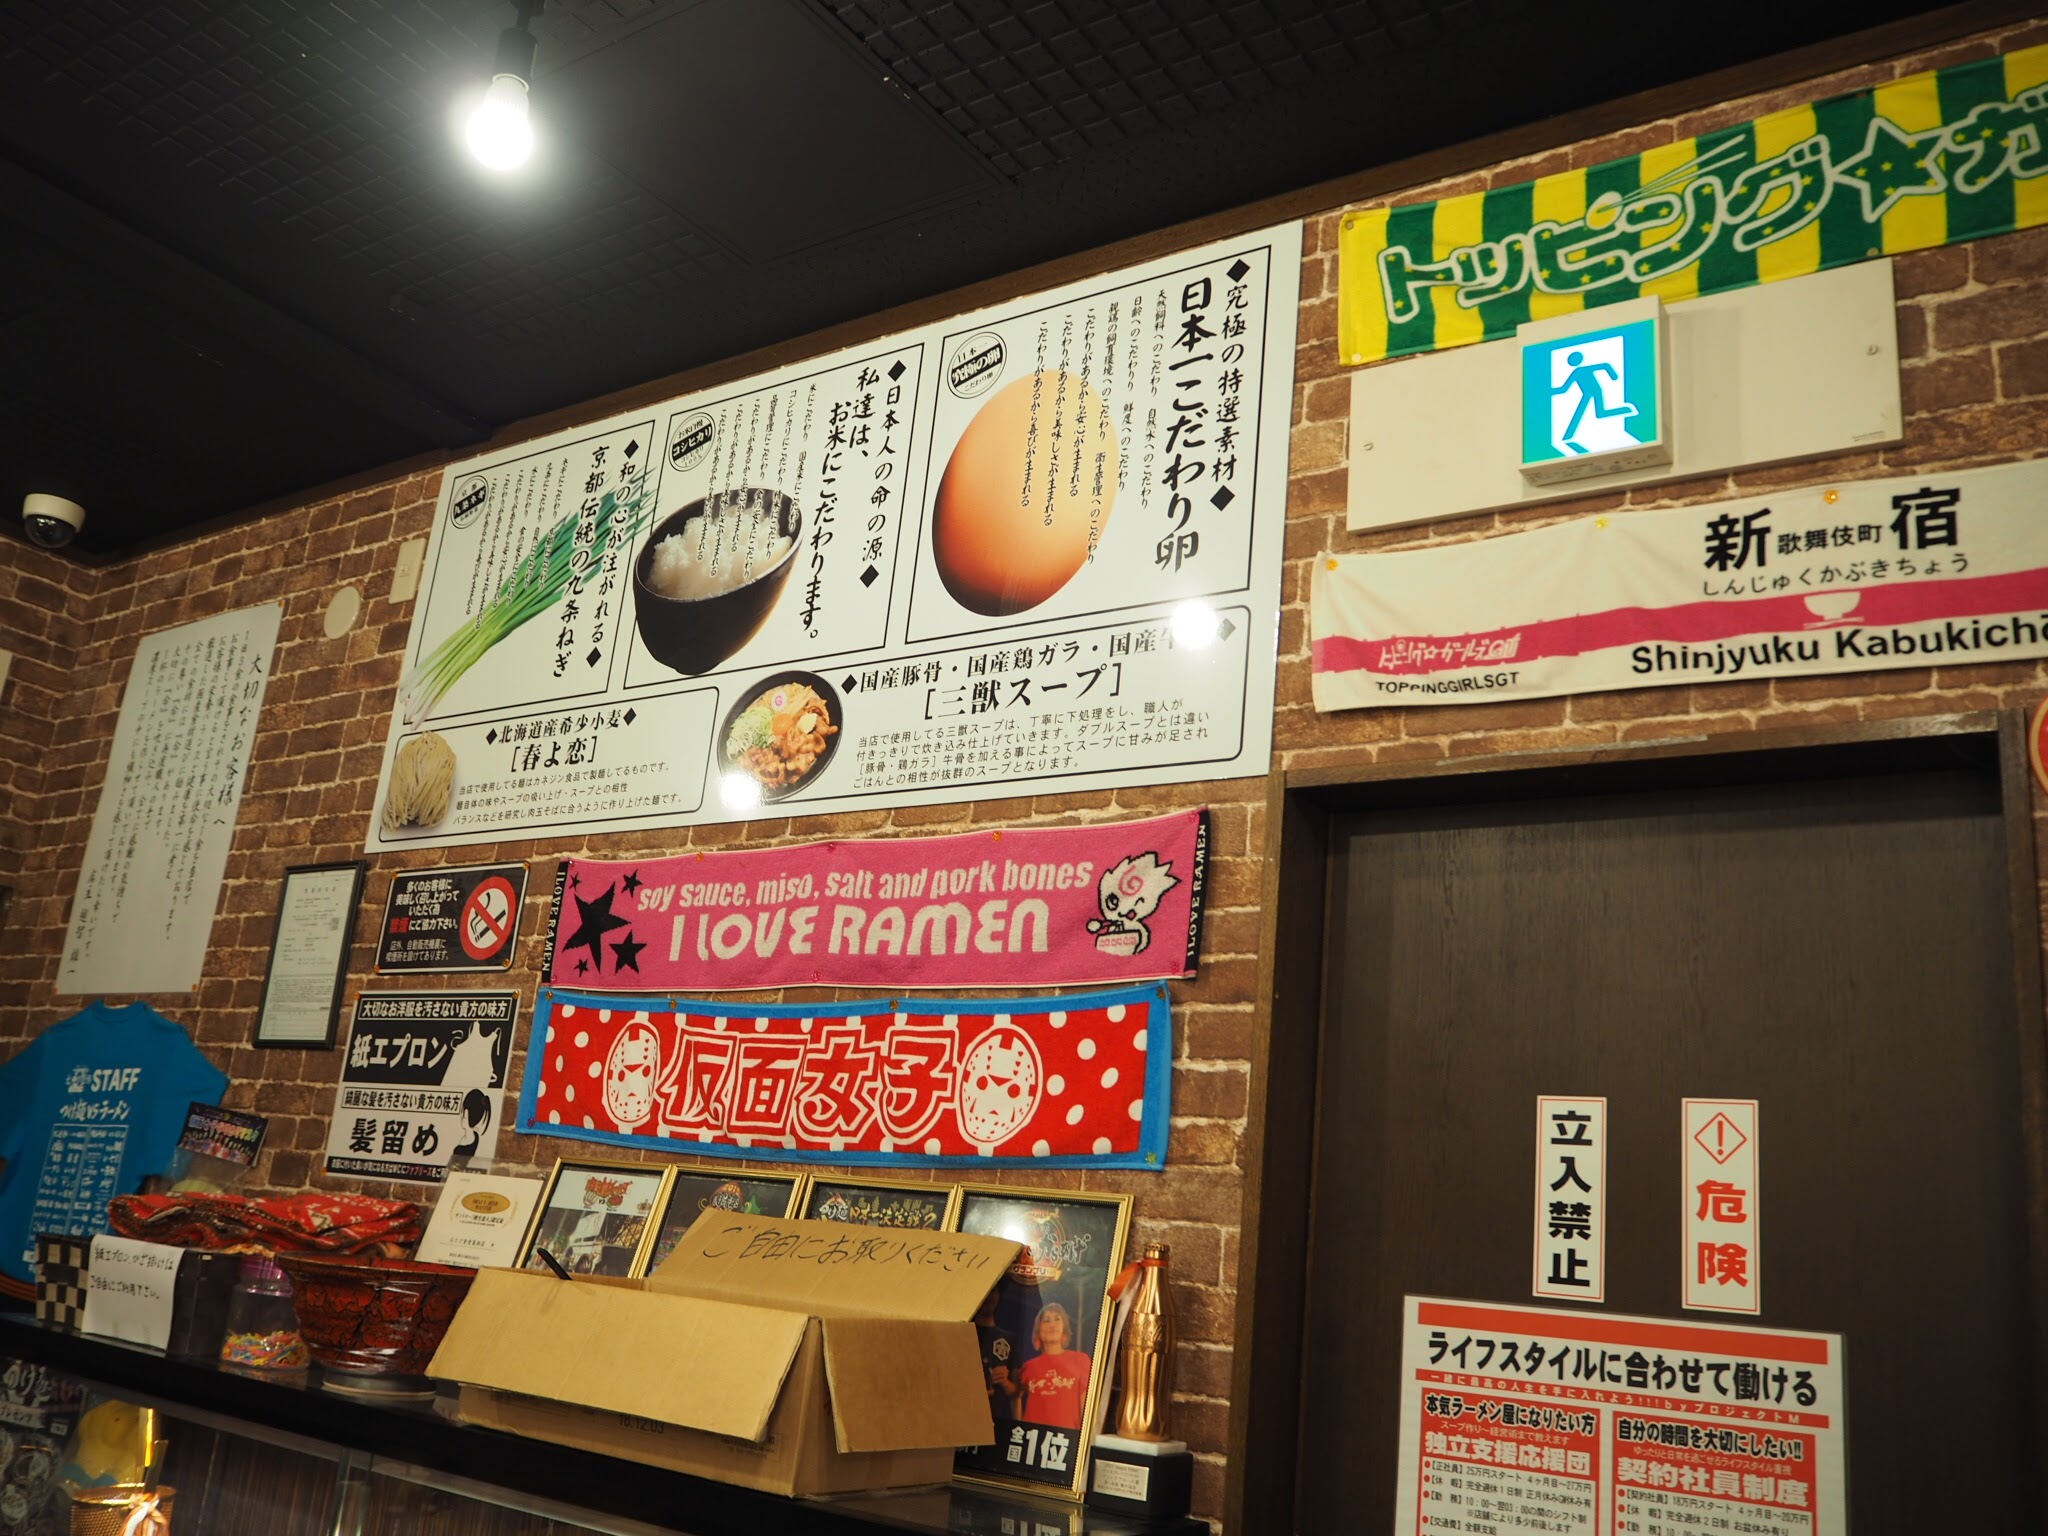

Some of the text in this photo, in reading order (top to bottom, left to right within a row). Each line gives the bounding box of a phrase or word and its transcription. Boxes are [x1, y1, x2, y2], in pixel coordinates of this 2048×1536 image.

[1069, 308, 1096, 497] こだわりがあるから安心が生まれる
[1211, 284, 1249, 482] 究極の特選素材
[849, 366, 881, 458] 私達は、
[1043, 314, 1073, 526] こだわりがあるから美味しさが生まれる
[1154, 277, 1217, 573] 日本一こだわり卵
[672, 426, 712, 457] コシヒカリ
[1141, 408, 1157, 509] 自然水へのこだわり
[862, 385, 901, 562] 日本人の命の源
[799, 401, 852, 639] お米にこだわります。
[1703, 486, 1960, 572] 新 歌舞伎町 宿
[553, 445, 610, 678] 京都伝統の九条ねぎ
[591, 461, 635, 644] 和の心が注がれる
[1702, 552, 1970, 596] しんじゅくかぶきちょう
[1631, 635, 1820, 675] Shinjyuku
[923, 662, 1122, 721] [三獣スープ]
[1376, 671, 1520, 694] TOPPINGGIRLSGT
[211, 652, 263, 826] 大切なお客様へ
[498, 709, 622, 744] 北海道産希少小麦
[856, 711, 1210, 762] 付きっきりで炊き込み仕上げていきます。ダブルスープとは違い
[858, 698, 1183, 748] 当店で使用してる三獣スープは、丁寧に下処理をし、職人が
[510, 735, 598, 773] [春よ恋]
[852, 755, 1080, 789] ごはんとの相性が抜群のスープとなります。
[1192, 824, 1207, 892] RAMEN
[406, 878, 453, 893] 多くのお客様に
[637, 859, 1094, 912] soy sauce, miso, salt and pork bones
[542, 919, 557, 972] RAMEN
[668, 897, 1050, 962] I LOVE RAMEN
[362, 999, 508, 1018] 大切なお洋服を汚さない貴方の味方
[350, 1032, 448, 1070] 紙エプロン
[90, 1067, 142, 1092] STAFF
[345, 1089, 460, 1112] 綺麗な髪を汚さない貴方の味方
[660, 1026, 960, 1144] 仮面女子
[348, 1117, 440, 1157] 髪留め
[1547, 1109, 1594, 1288] 立入禁止
[702, 1226, 990, 1272] ご自由にお取りください
[1695, 1178, 1749, 1289] 危険
[1428, 1331, 1818, 1407] ライフスタイルに合わせて働ける
[1425, 1393, 1595, 1436] 本気ラーメン屋になりたい方
[1617, 1417, 1804, 1460] 自分の時間を大切にしたい!!
[1424, 1431, 1591, 1476] 独立支援応援団
[1617, 1456, 1809, 1508] 契約社員制度
